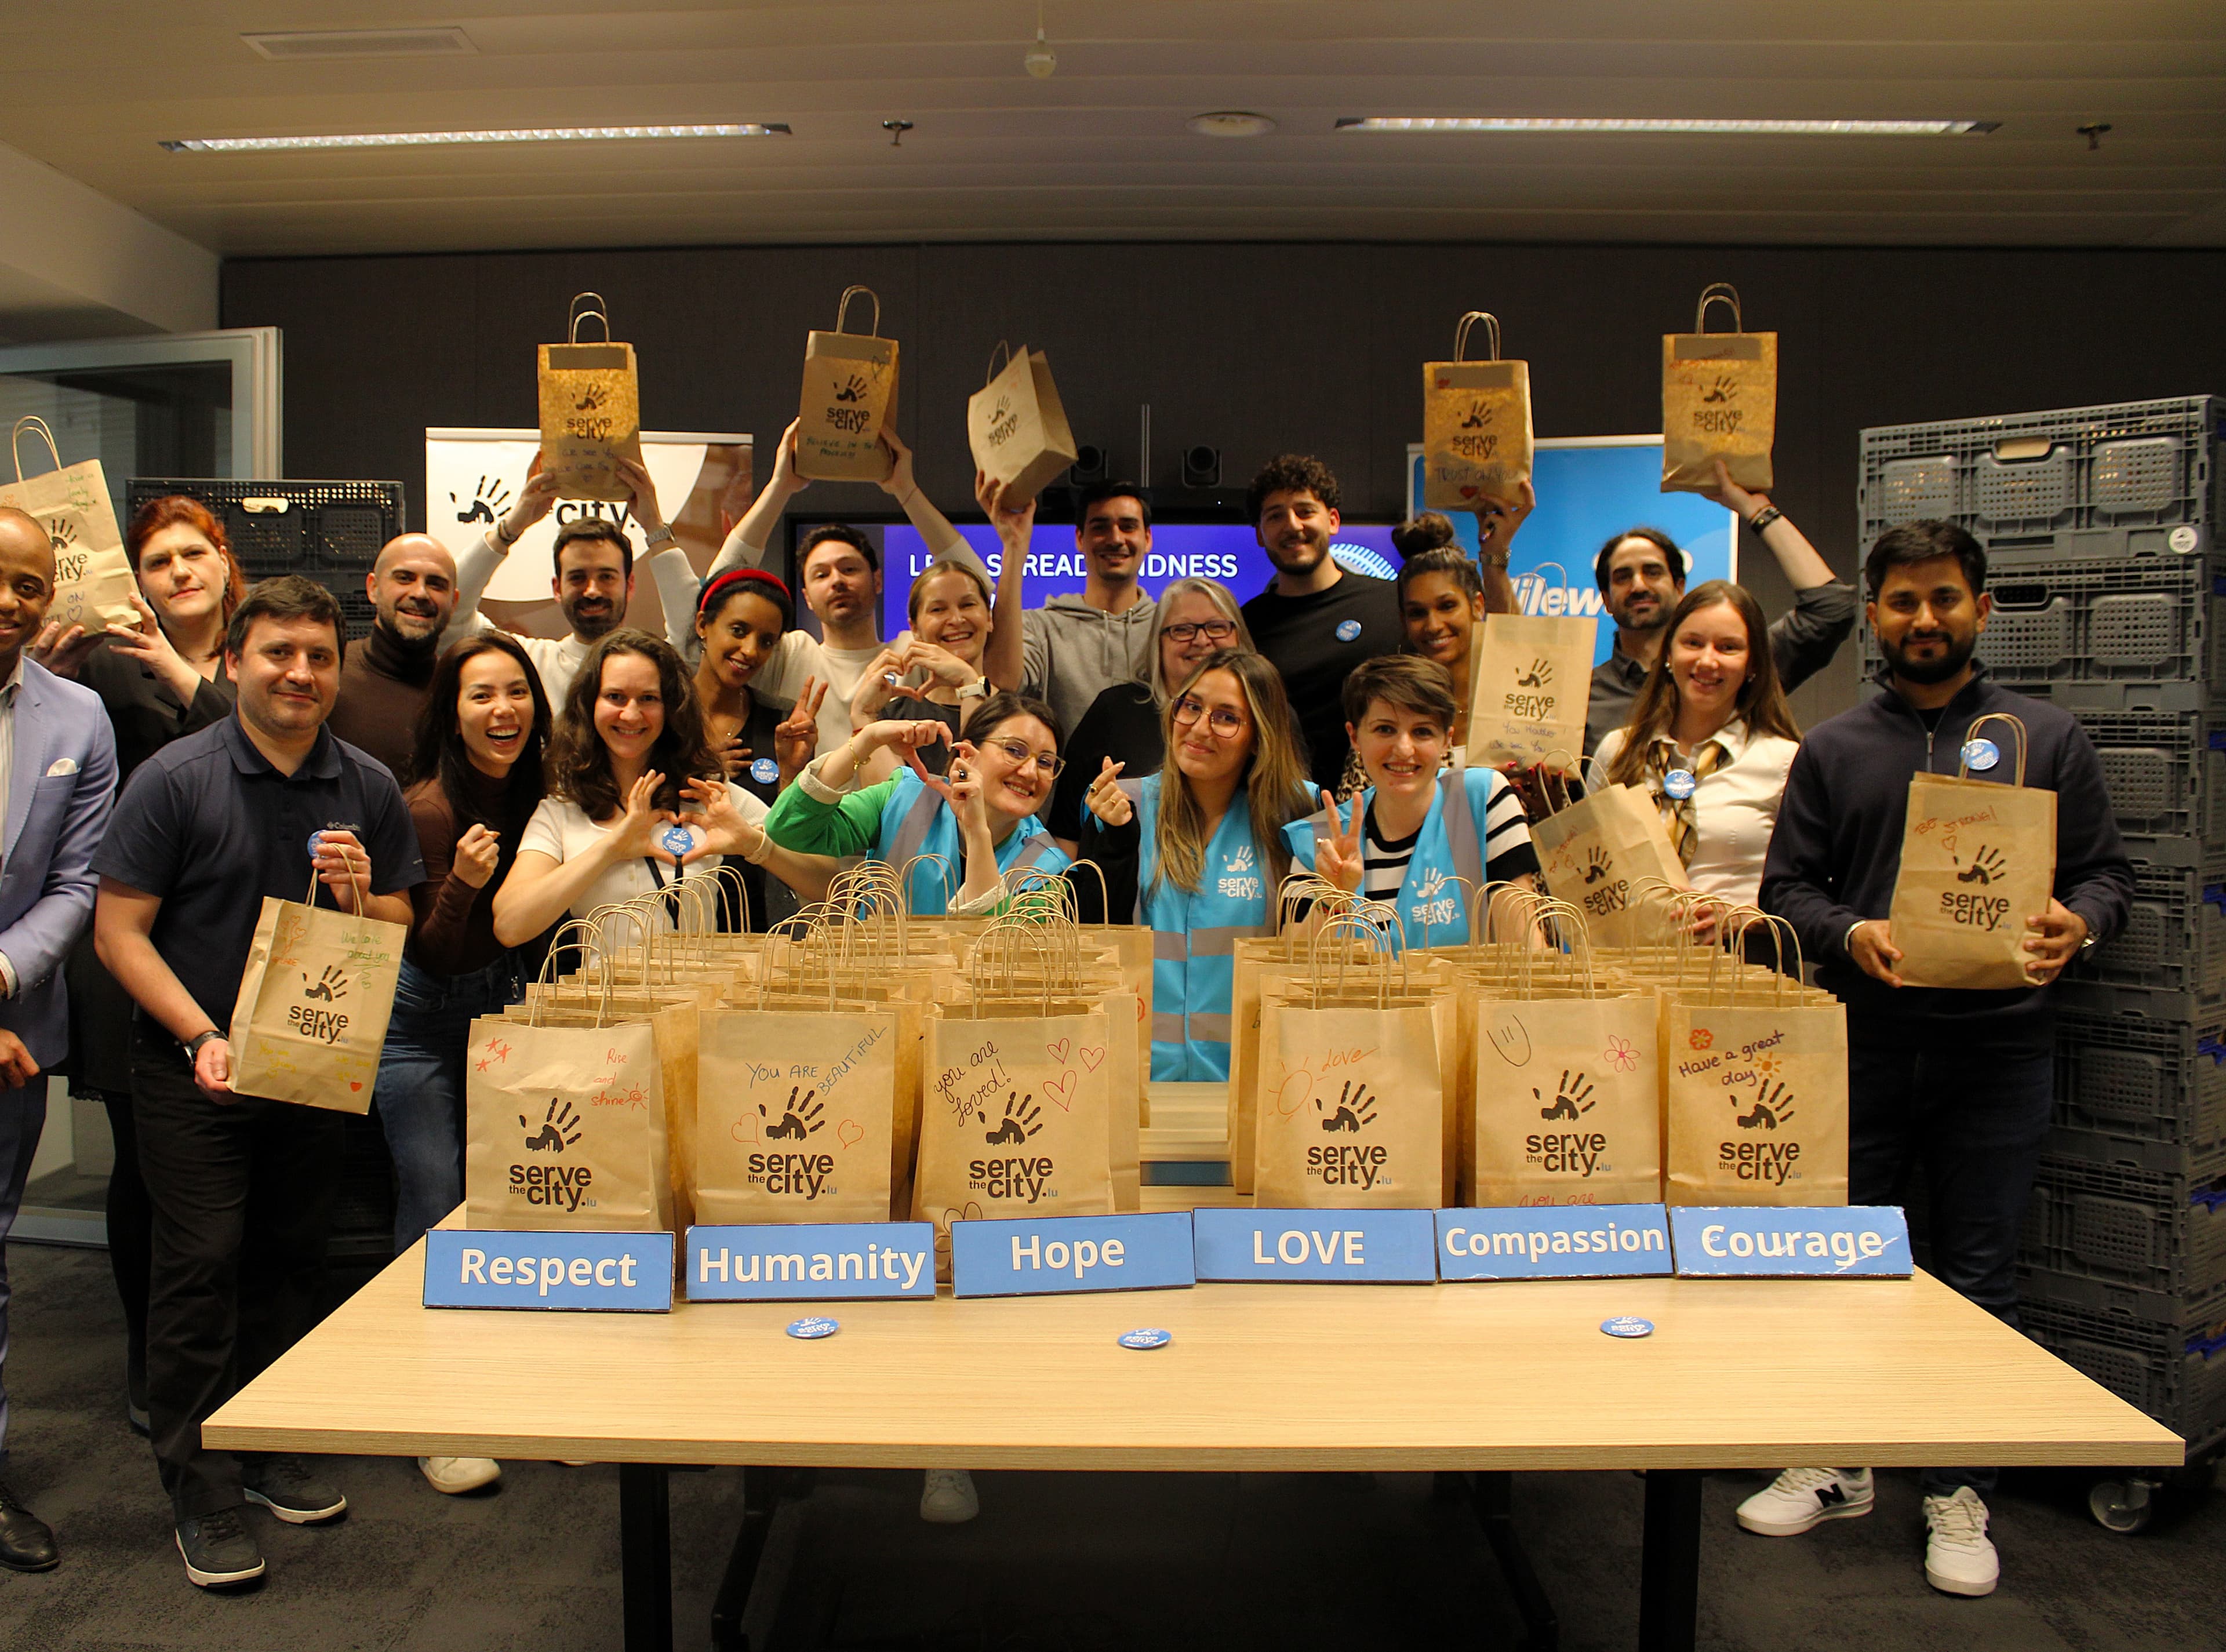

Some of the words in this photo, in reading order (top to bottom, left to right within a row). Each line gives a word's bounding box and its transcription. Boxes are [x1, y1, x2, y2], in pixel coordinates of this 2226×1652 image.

[566, 417, 612, 428] serve
[827, 407, 870, 421] serve
[1694, 410, 1743, 422] serve
[1453, 435, 1497, 446] serve
[58, 553, 88, 568] rve
[1505, 693, 1555, 708] serve
[1915, 818, 1938, 835] BE
[1944, 805, 1998, 834] STRONG!
[1219, 877, 1259, 889] serve
[1584, 879, 1630, 909] serve
[1942, 892, 2010, 913] serve
[1412, 898, 1456, 918] serve
[287, 1019, 300, 1027] the
[289, 1005, 349, 1029] serve
[606, 1047, 627, 1065] Rise
[1679, 1056, 1721, 1078] Have
[1725, 1051, 1738, 1060] a
[1741, 1029, 1785, 1062] great
[593, 1072, 616, 1086] and
[745, 1062, 780, 1089] YOU
[789, 1064, 819, 1078] ARE
[933, 1067, 966, 1104] you
[970, 1040, 999, 1067] are
[1721, 1070, 1757, 1087] day
[591, 1090, 625, 1107] shine
[1526, 1133, 1606, 1154] serve
[1719, 1141, 1800, 1161] serve
[748, 1153, 834, 1174] serve
[1308, 1145, 1388, 1166] serve
[1526, 1154, 1543, 1163] the
[1719, 1161, 1736, 1170] the
[510, 1165, 592, 1187] serve
[969, 1157, 1054, 1179] serve
[1307, 1166, 1323, 1176] the
[748, 1174, 765, 1184] the
[969, 1180, 987, 1189] the
[509, 1185, 526, 1195] the
[1567, 1193, 1596, 1206] are
[1253, 1229, 1365, 1266] LOVE
[1444, 1222, 1665, 1265] Compassion
[1701, 1224, 1885, 1268] Courage
[699, 1243, 927, 1291] Humanity
[1010, 1235, 1125, 1280] Hope
[460, 1247, 638, 1297] Respect
